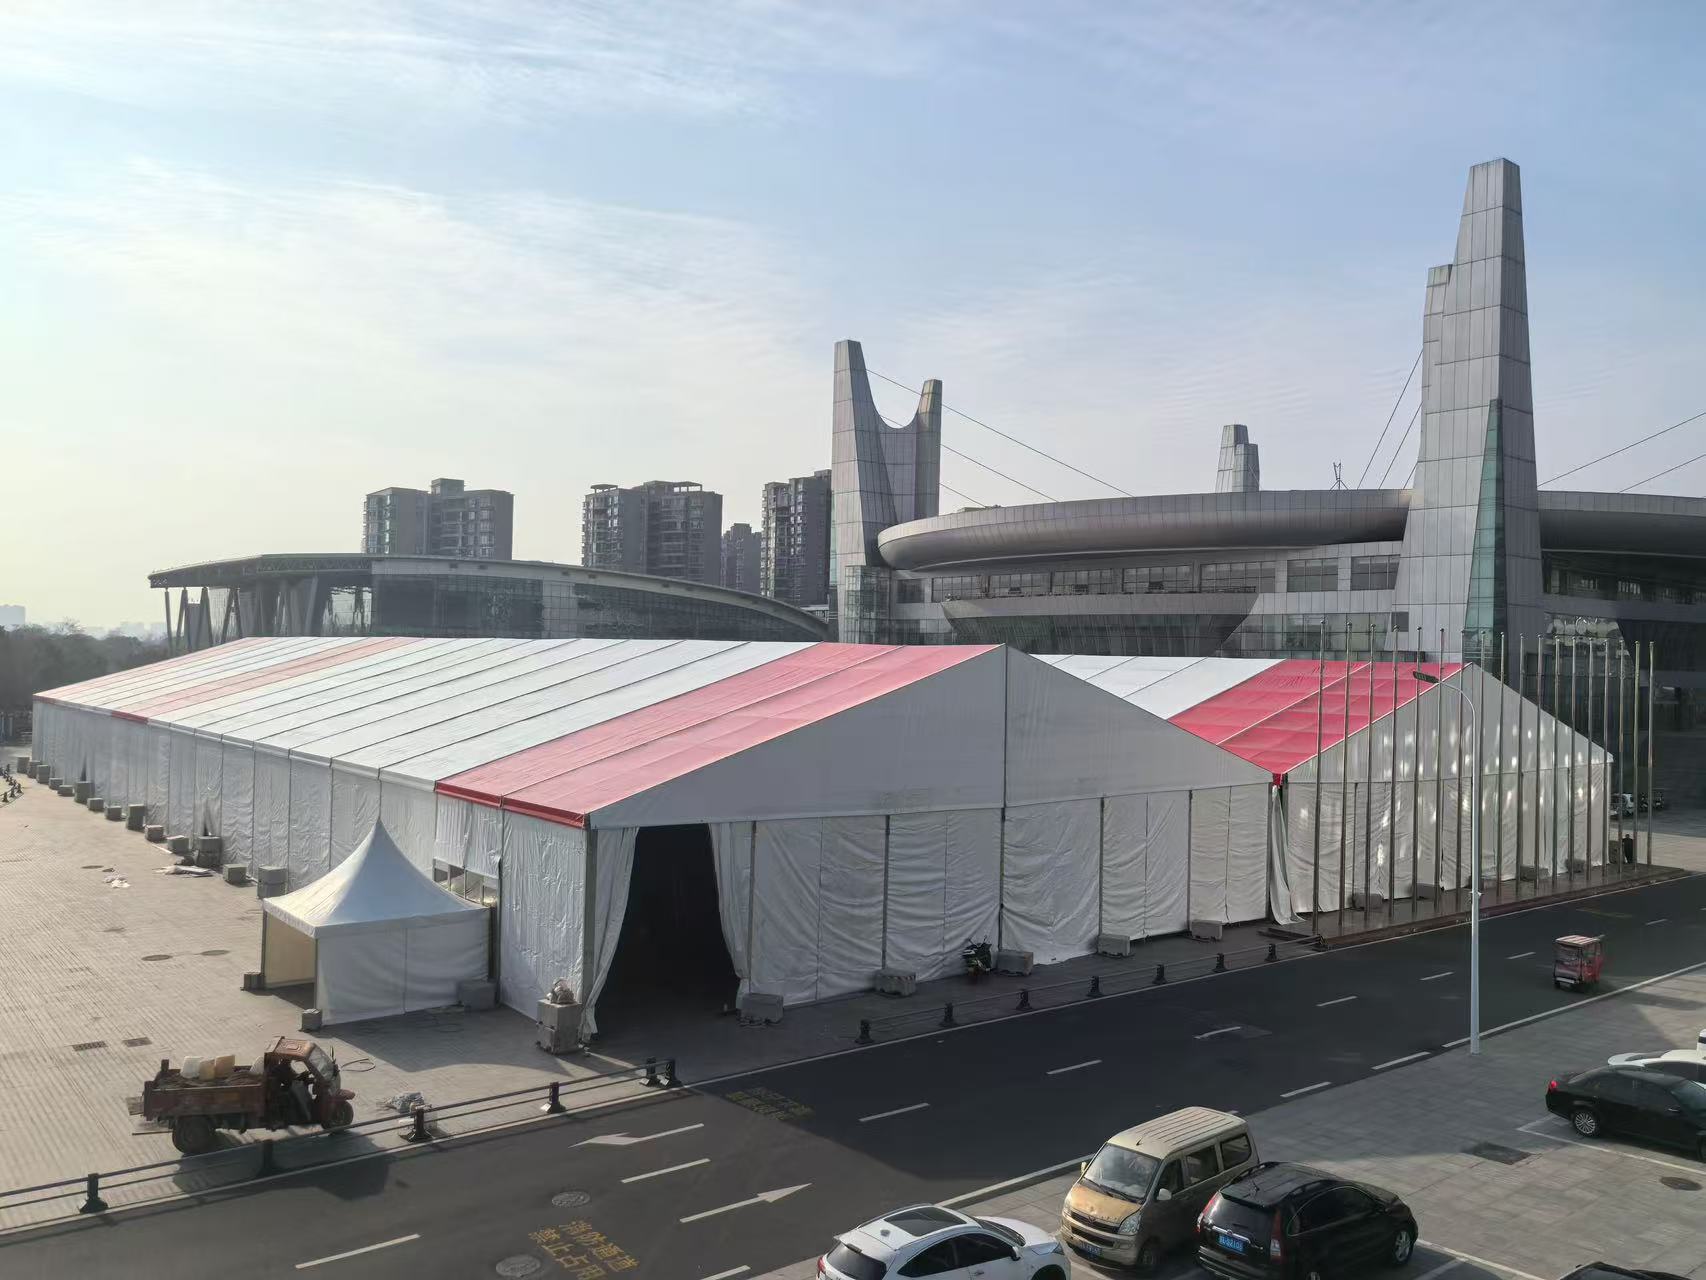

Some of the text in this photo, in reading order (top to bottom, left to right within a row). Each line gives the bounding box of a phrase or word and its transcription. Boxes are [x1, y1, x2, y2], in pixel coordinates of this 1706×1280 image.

[528, 1228, 607, 1280] 禁止占用
[559, 1220, 639, 1272] 消防通道
